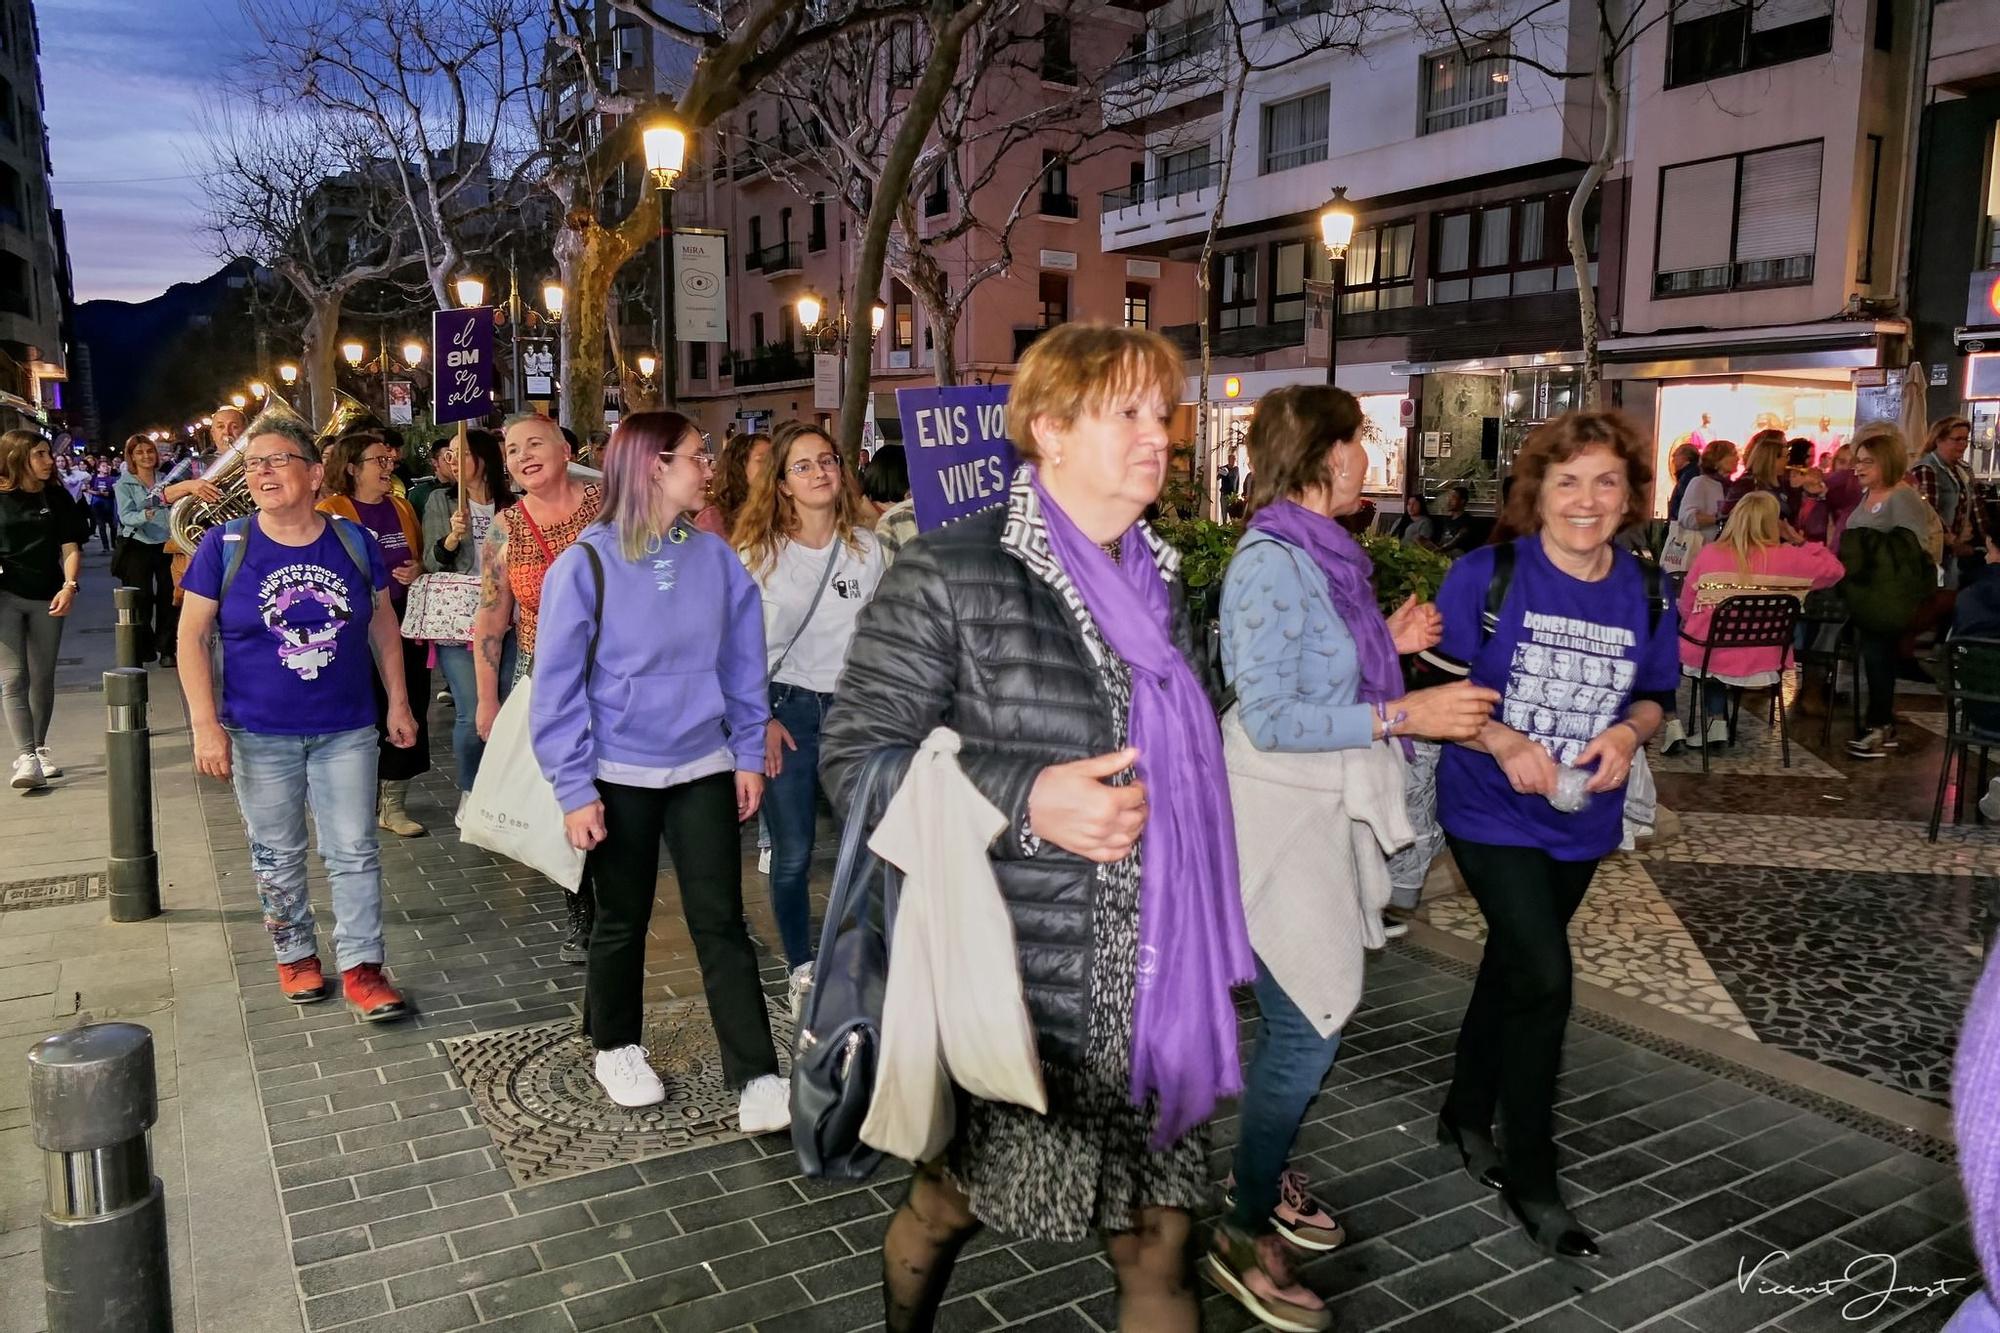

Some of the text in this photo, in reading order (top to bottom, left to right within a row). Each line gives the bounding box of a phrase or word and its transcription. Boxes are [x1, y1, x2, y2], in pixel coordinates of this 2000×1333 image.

[453, 318, 476, 348] el
[447, 348, 480, 367] 8M
[447, 374, 484, 406] sale
[454, 369, 474, 385] se
[915, 404, 1015, 448] ENS VOL
[937, 455, 1005, 505] VIVES
[258, 571, 349, 600] IMPARABLES
[266, 564, 337, 582] JUNTAS SOMOS
[1568, 618, 1586, 638] EN
[1532, 631, 1626, 657] PER LA IGUALTAT
